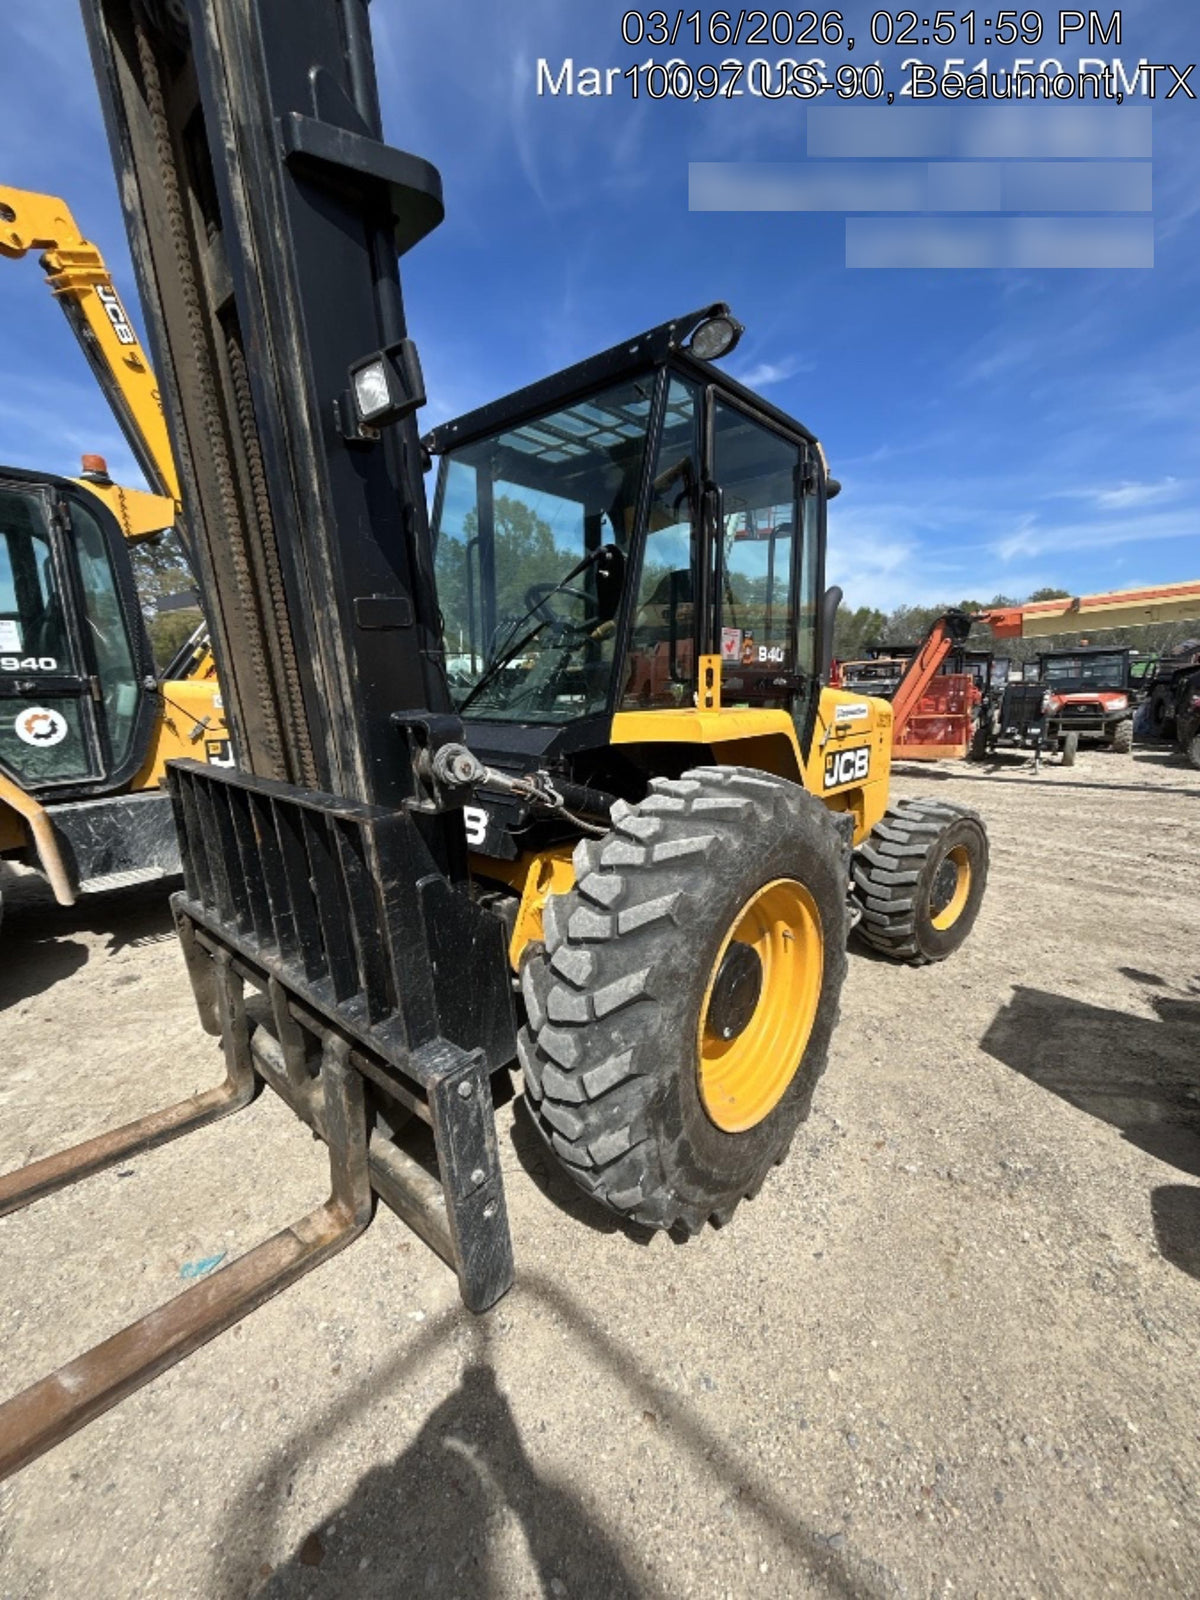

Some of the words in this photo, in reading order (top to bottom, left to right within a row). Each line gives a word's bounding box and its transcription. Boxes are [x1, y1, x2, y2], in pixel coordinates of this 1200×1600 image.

[96, 285, 136, 344] JCB
[0, 657, 58, 671] 940
[824, 747, 869, 787] JCB
